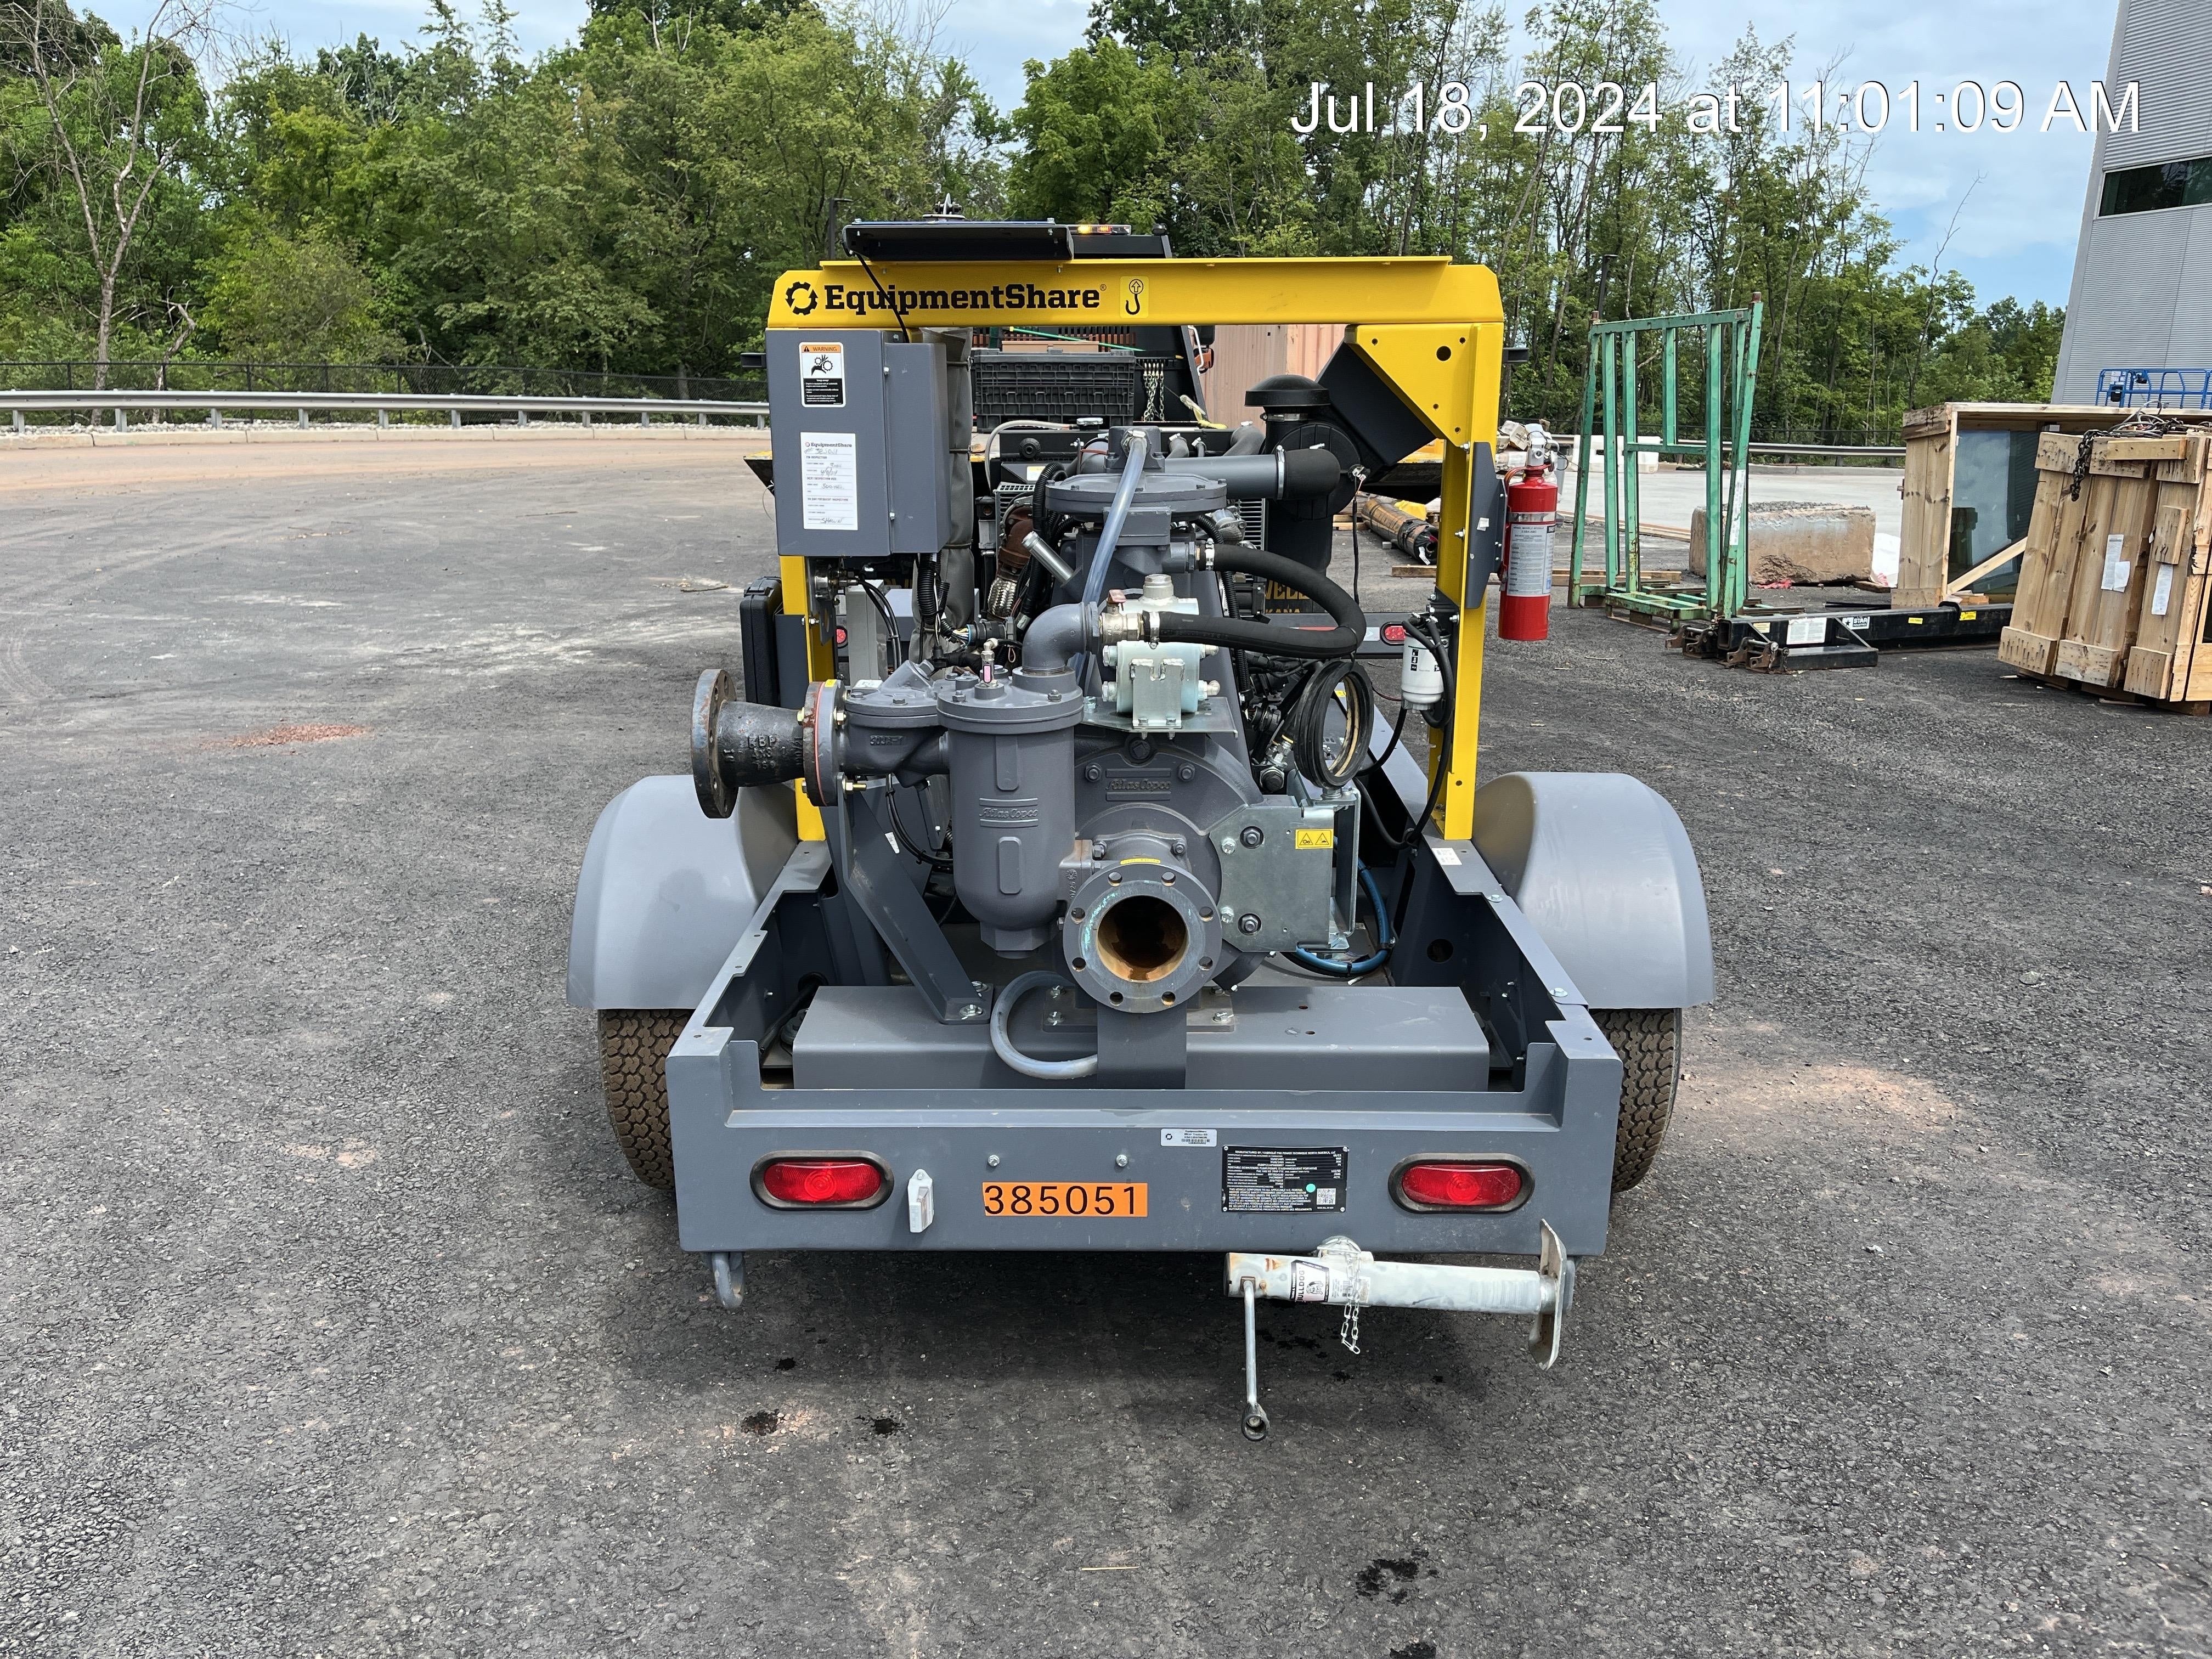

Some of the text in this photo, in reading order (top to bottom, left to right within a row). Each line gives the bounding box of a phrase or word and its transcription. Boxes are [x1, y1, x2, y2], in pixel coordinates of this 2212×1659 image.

[825, 283, 1101, 316] EquipmentShare
[979, 807, 1039, 820] Atlas Copco
[984, 1185, 1134, 1215] 385051
